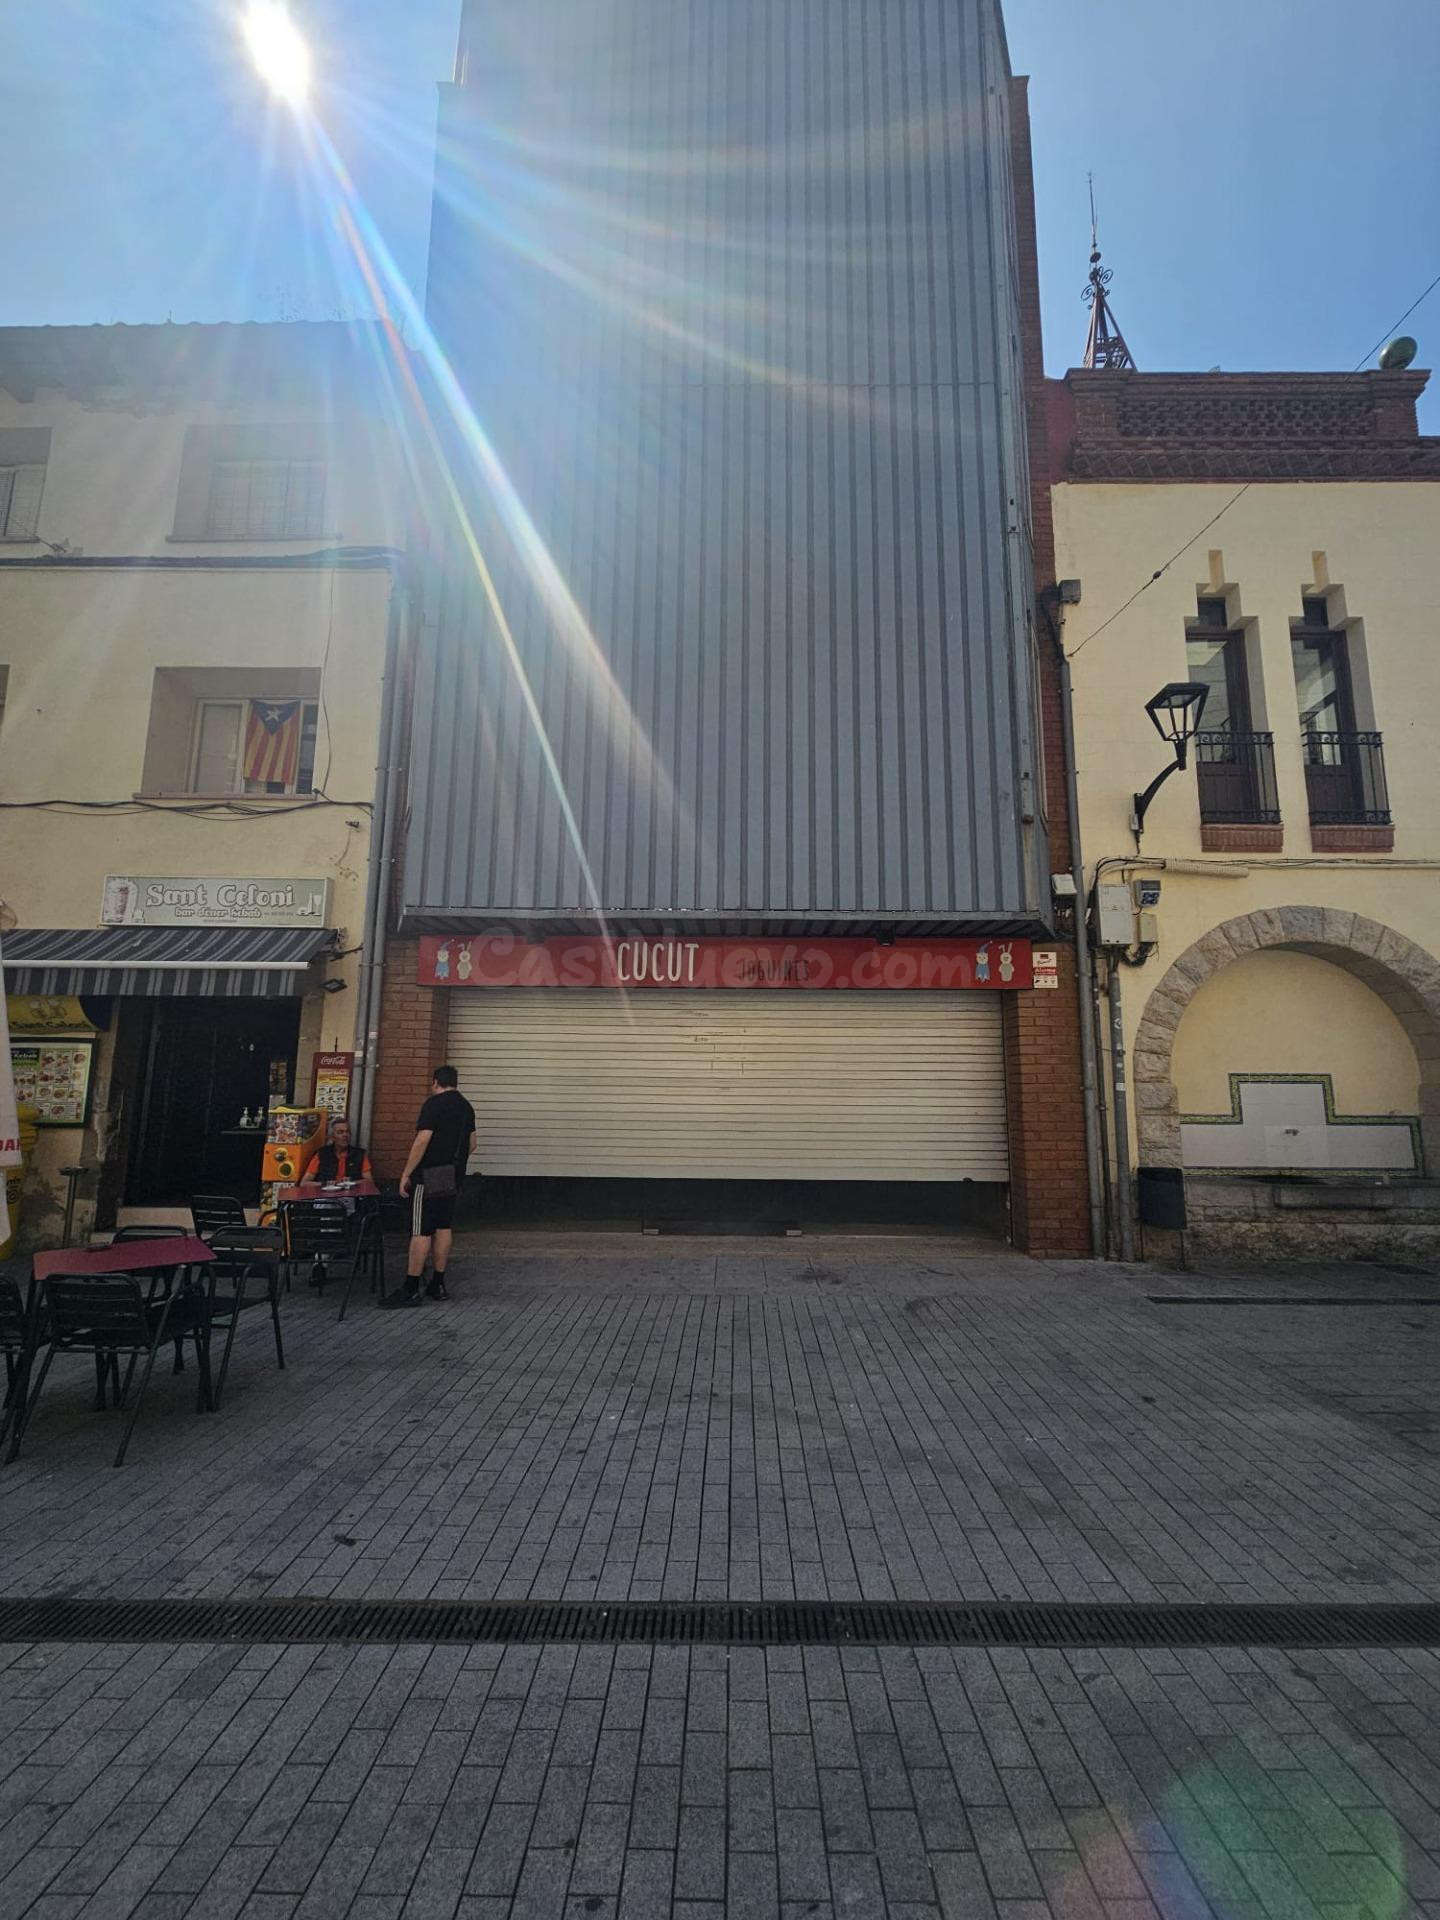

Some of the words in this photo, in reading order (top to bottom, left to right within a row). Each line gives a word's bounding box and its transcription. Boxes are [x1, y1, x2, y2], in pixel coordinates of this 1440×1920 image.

[146, 883, 207, 907] Sant
[217, 884, 295, 907] Celoni
[617, 942, 699, 982] CUCUT
